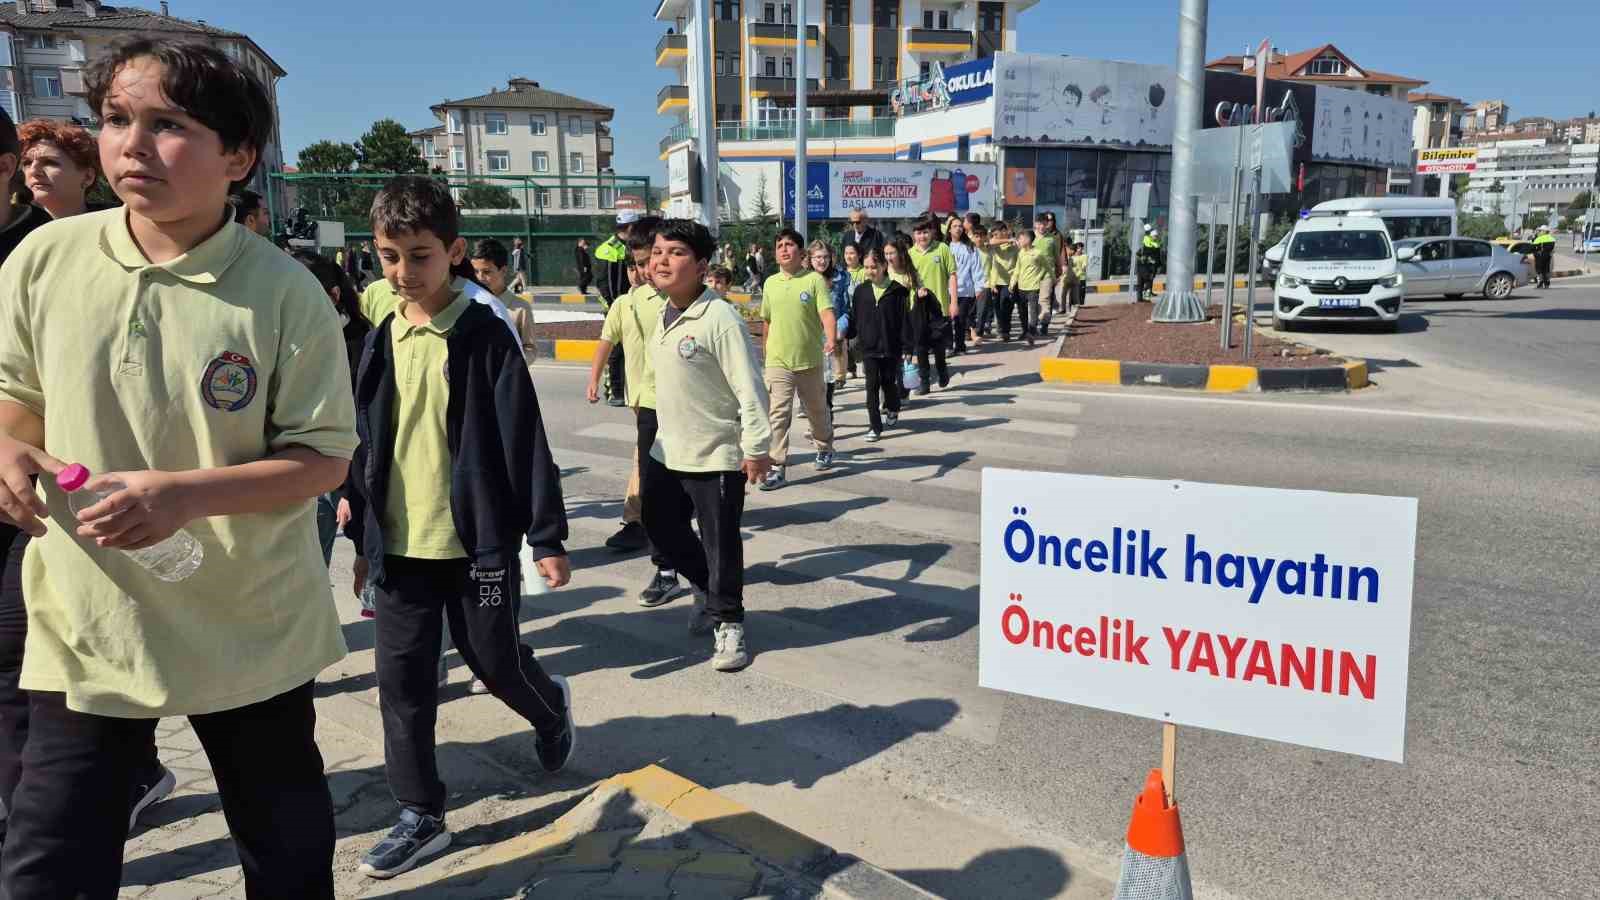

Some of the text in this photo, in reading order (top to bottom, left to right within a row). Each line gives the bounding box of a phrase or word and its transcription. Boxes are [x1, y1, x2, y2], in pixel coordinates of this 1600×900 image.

[948, 69, 993, 92] OKULLA
[1422, 149, 1475, 161] Bilginler
[843, 185, 915, 197] KAYITLARIMIZ
[842, 199, 906, 210] BAŞLAMIŞTIR
[1004, 506, 1379, 604] Öncelik hayatın
[1001, 593, 1377, 700] Öncelik YAYANIN
